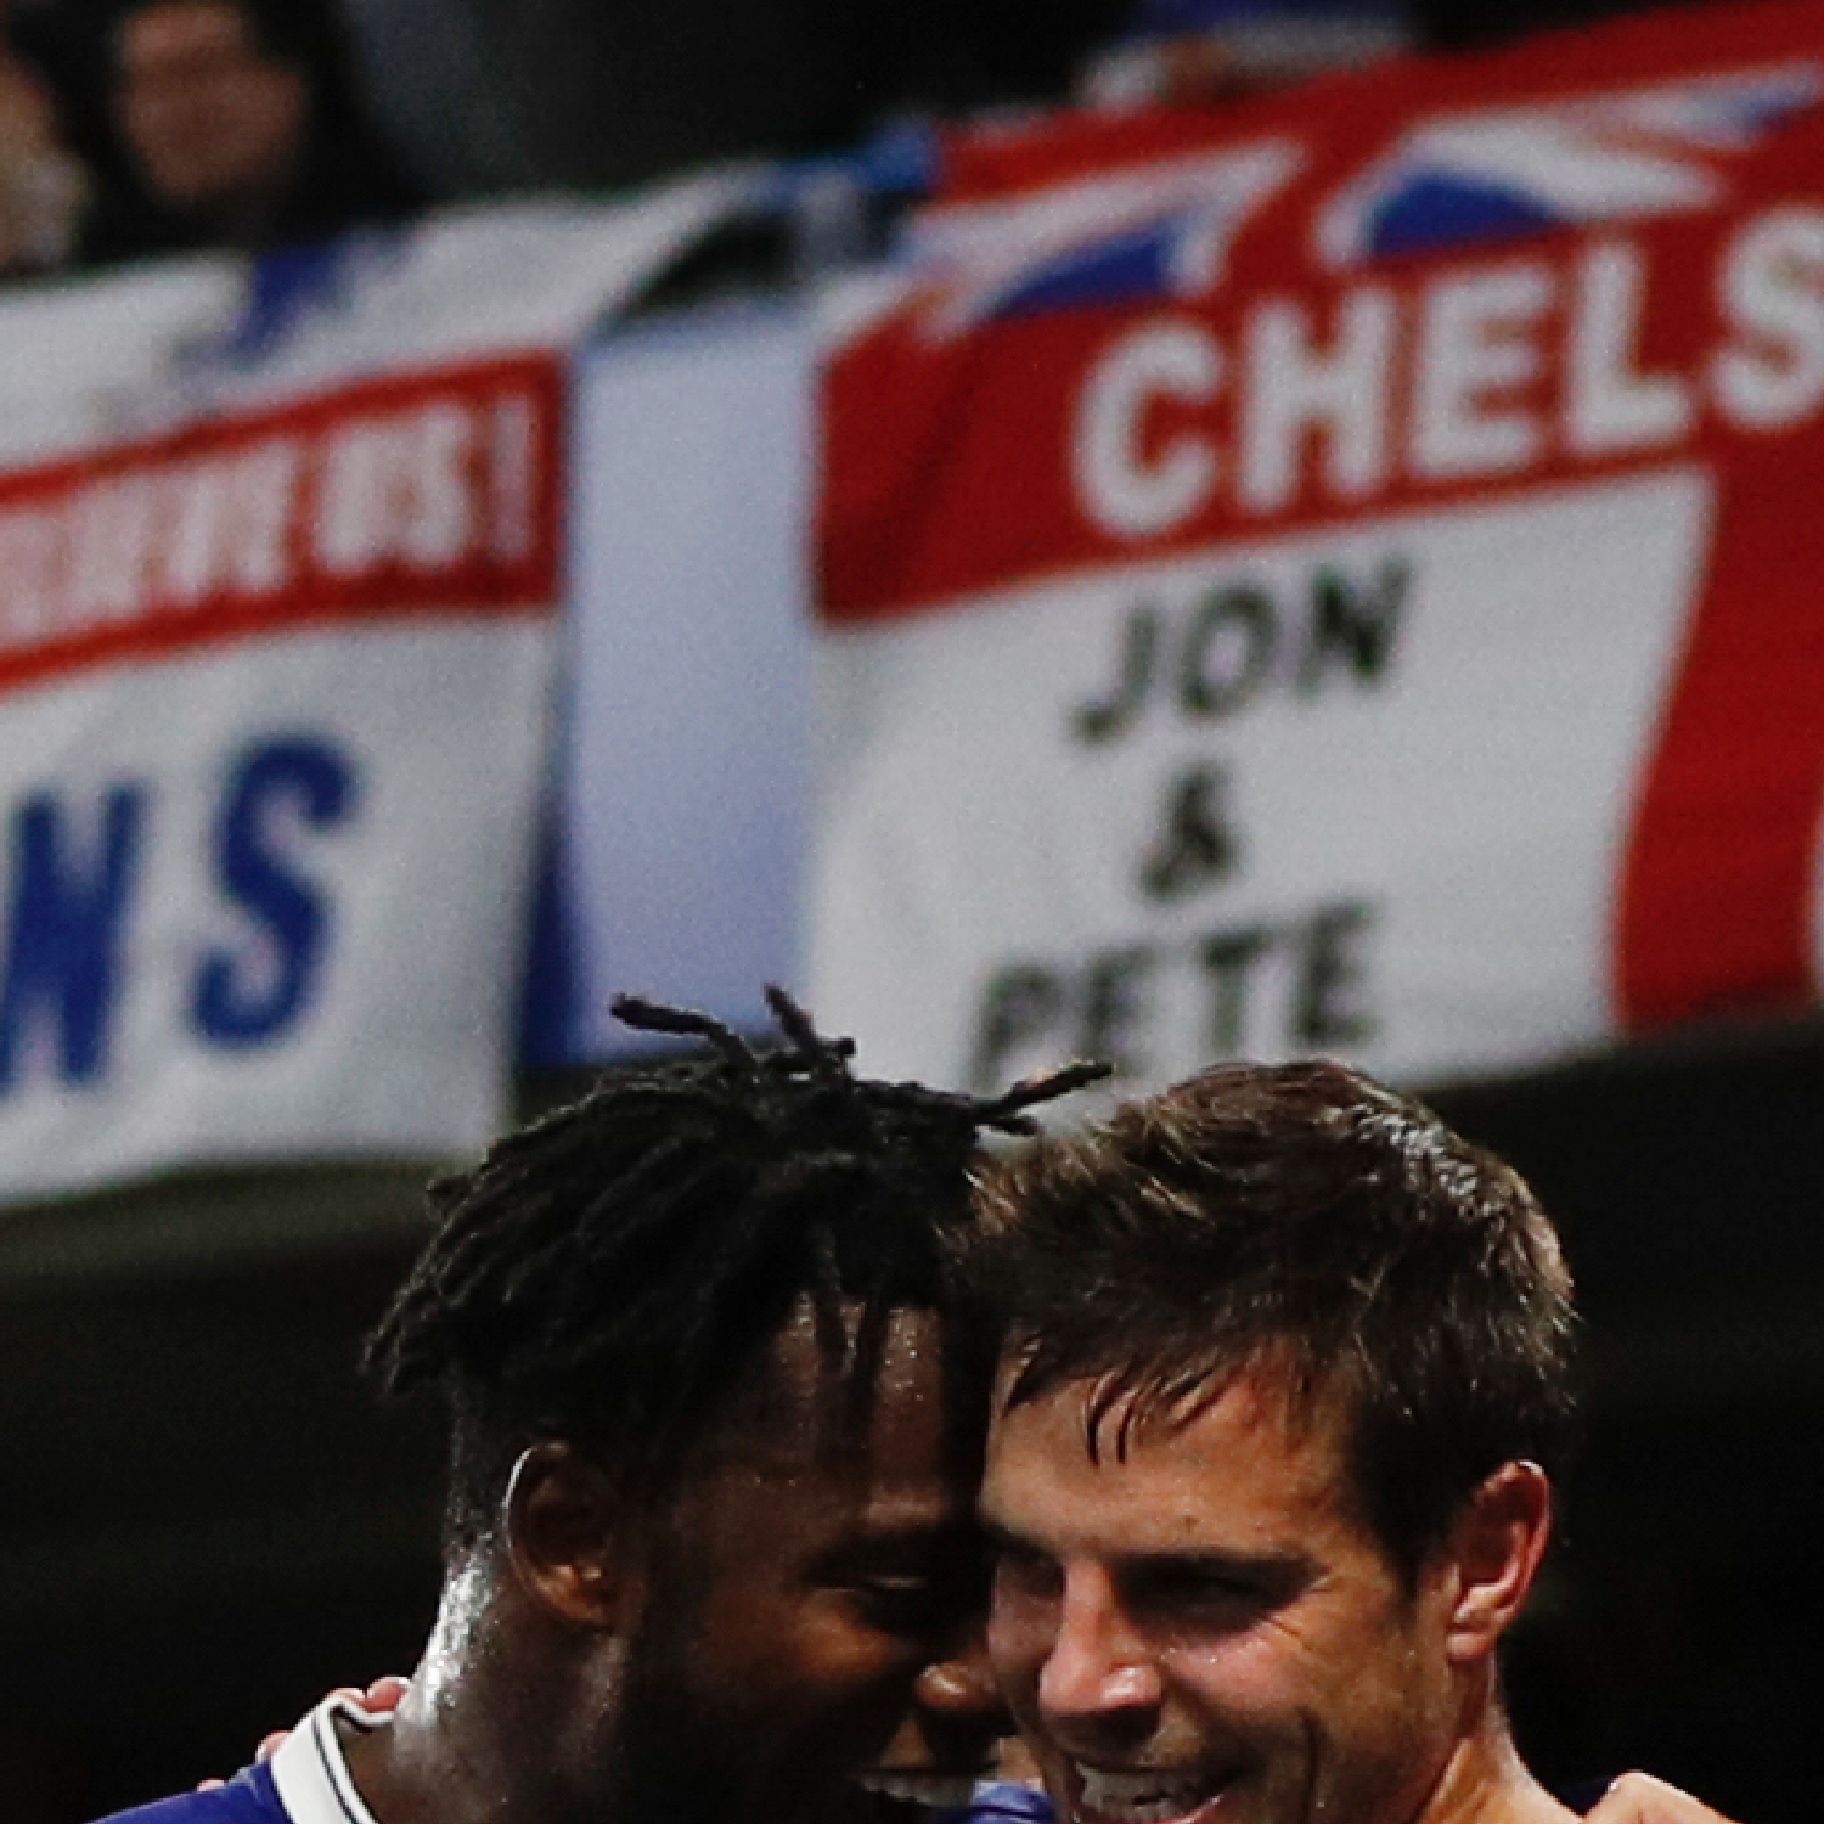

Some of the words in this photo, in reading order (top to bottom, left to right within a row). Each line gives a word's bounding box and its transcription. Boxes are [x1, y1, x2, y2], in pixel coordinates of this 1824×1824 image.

[1068, 556, 1416, 748] JON
[1134, 760, 1242, 903] &
[974, 900, 1380, 1092] PETE
